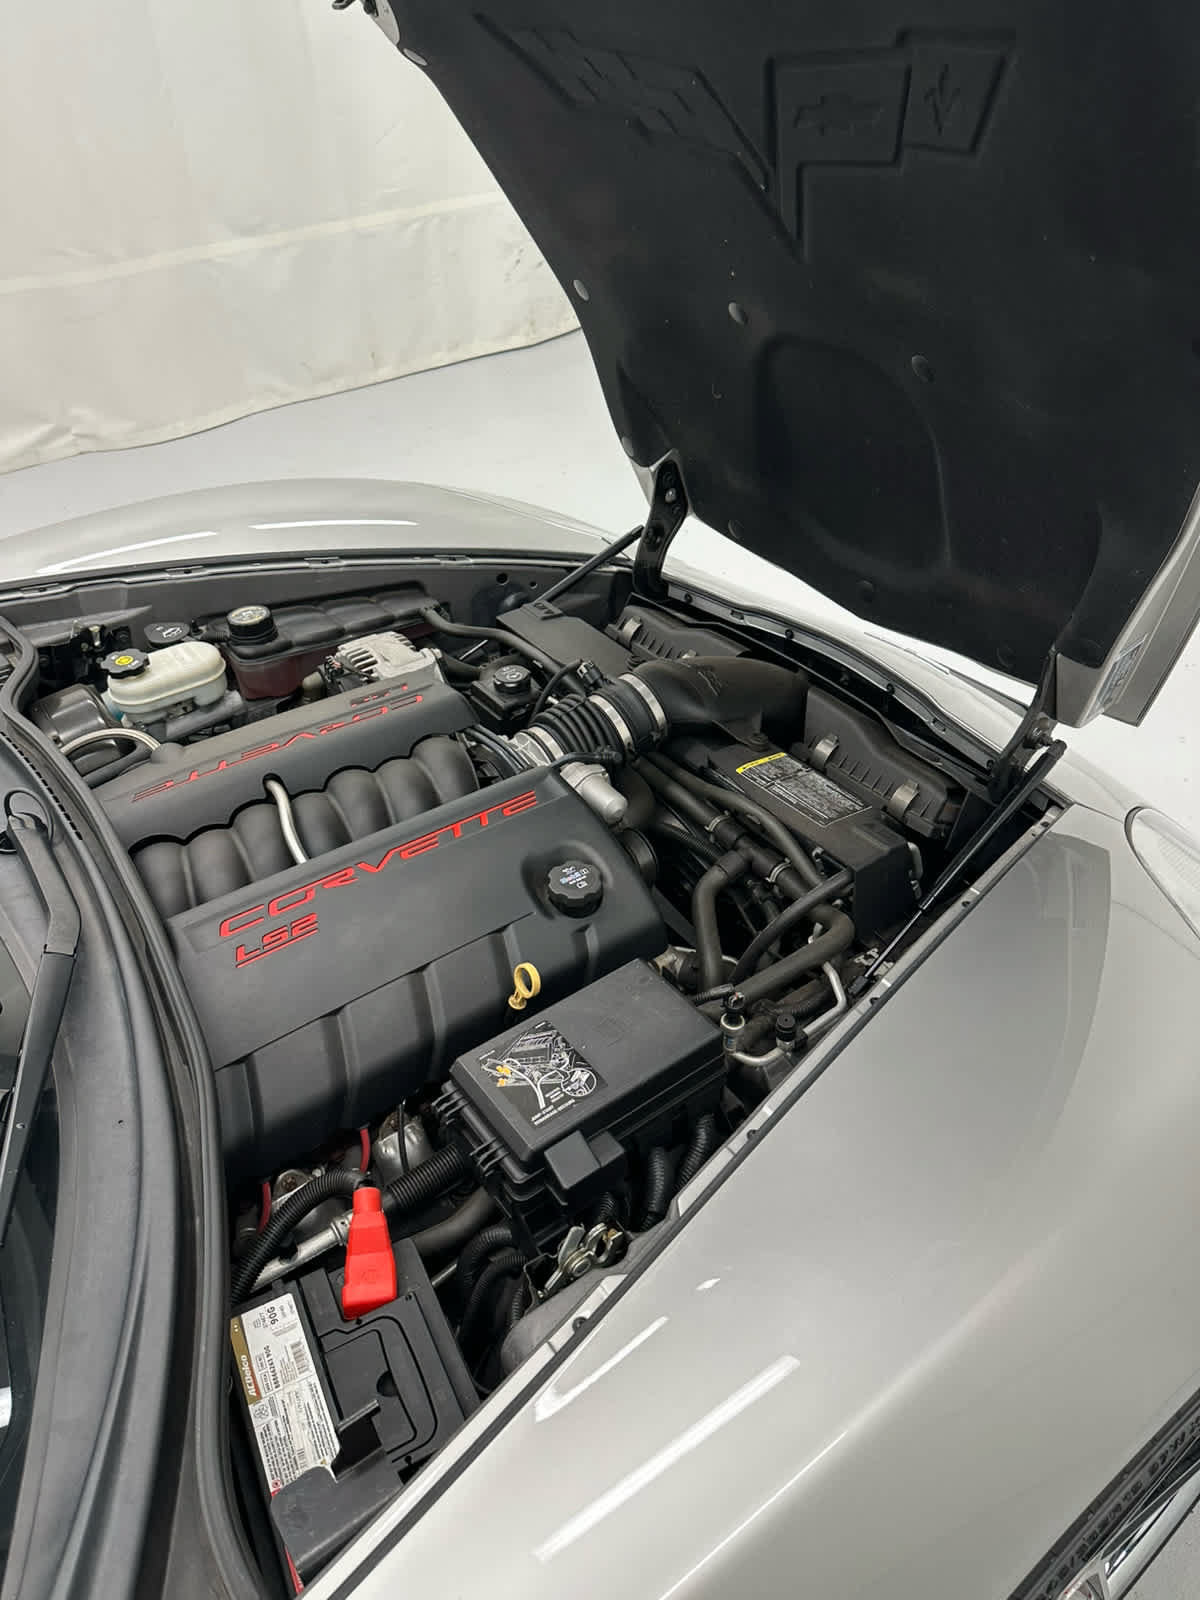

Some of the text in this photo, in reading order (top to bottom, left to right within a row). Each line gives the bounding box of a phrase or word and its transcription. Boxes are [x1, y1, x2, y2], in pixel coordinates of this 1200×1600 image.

[132, 694, 423, 803] CORVETTE
[219, 790, 538, 937] CORVETTE
[235, 912, 319, 963] LS2
[266, 1306, 279, 1325] 90G
[240, 1355, 257, 1397] ACDelco
